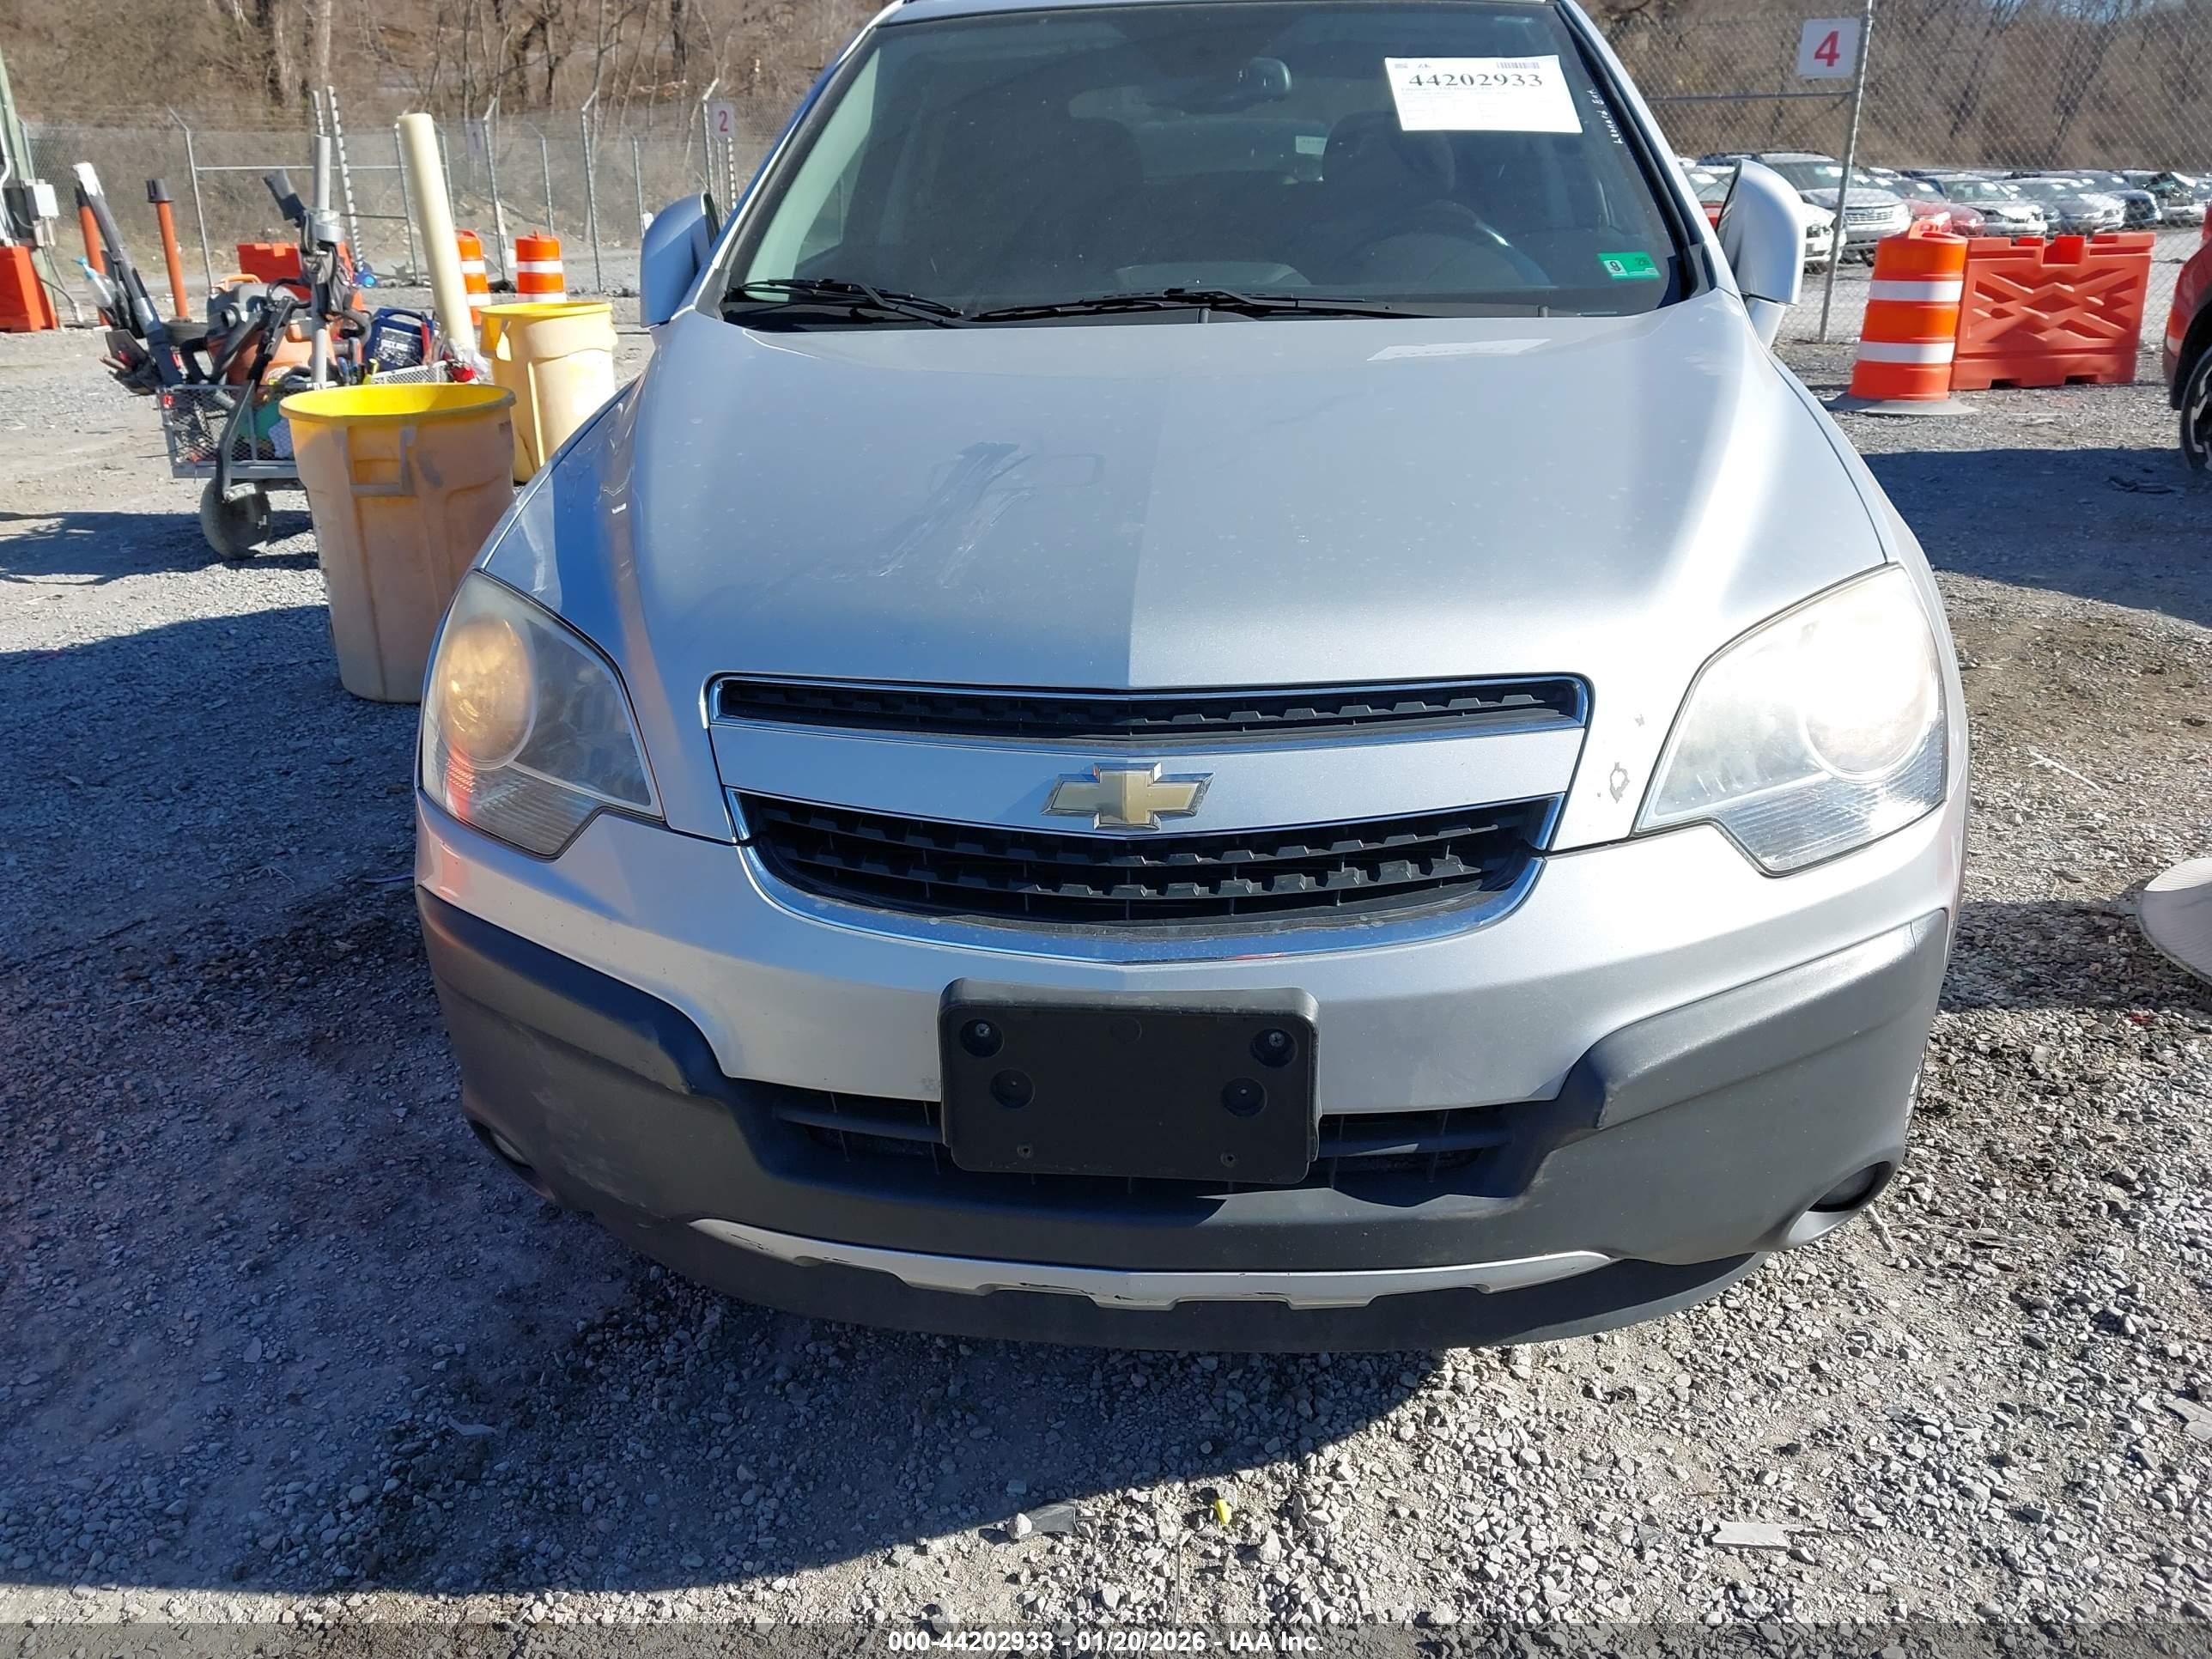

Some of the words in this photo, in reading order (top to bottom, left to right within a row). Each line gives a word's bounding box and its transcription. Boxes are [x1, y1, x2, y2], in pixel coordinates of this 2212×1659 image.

[1814, 30, 1840, 67] 4
[1408, 73, 1543, 87] 44202933
[718, 110, 728, 132] 2
